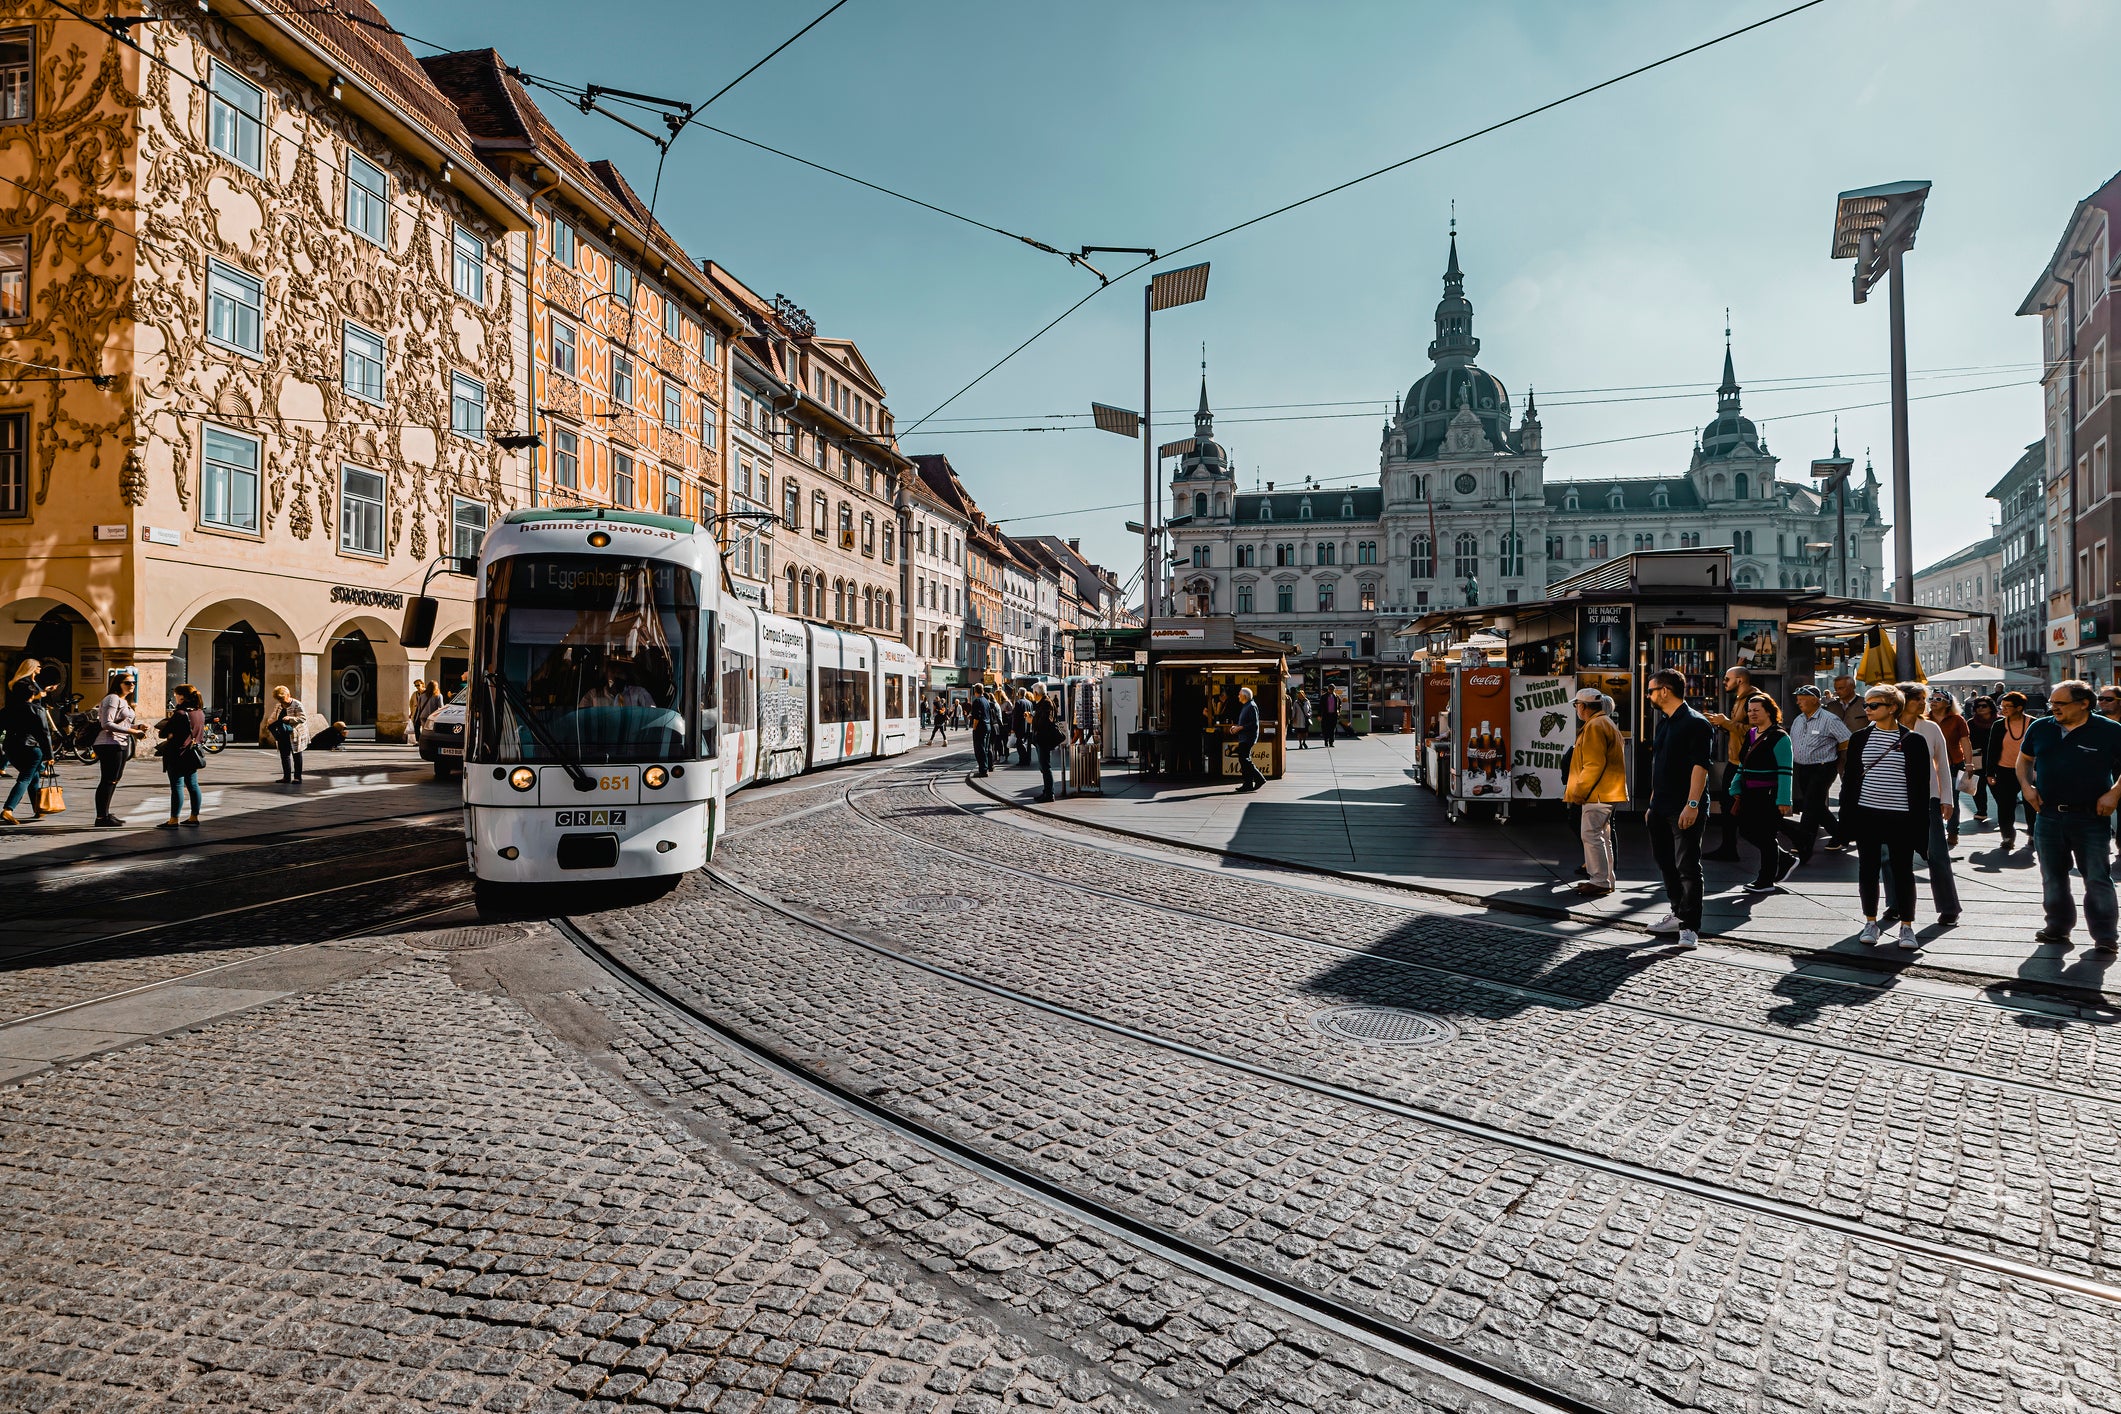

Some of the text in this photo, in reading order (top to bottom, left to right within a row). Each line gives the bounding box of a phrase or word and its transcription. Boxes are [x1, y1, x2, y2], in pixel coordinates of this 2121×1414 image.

[519, 522, 677, 541] hammerl-bewo.at
[528, 563, 536, 589] 1
[1706, 563, 1718, 586] 1
[1587, 607, 1622, 615] DIE NACHT
[1589, 615, 1620, 623] IST JUNG.
[1342, 650, 1348, 659] 8
[1469, 674, 1502, 686] Coca-Cola
[1525, 679, 1560, 692] frischer
[1514, 687, 1568, 713] STURM
[1531, 740, 1565, 751] frischer
[599, 775, 630, 791] 651
[557, 811, 623, 826] GRAZ
